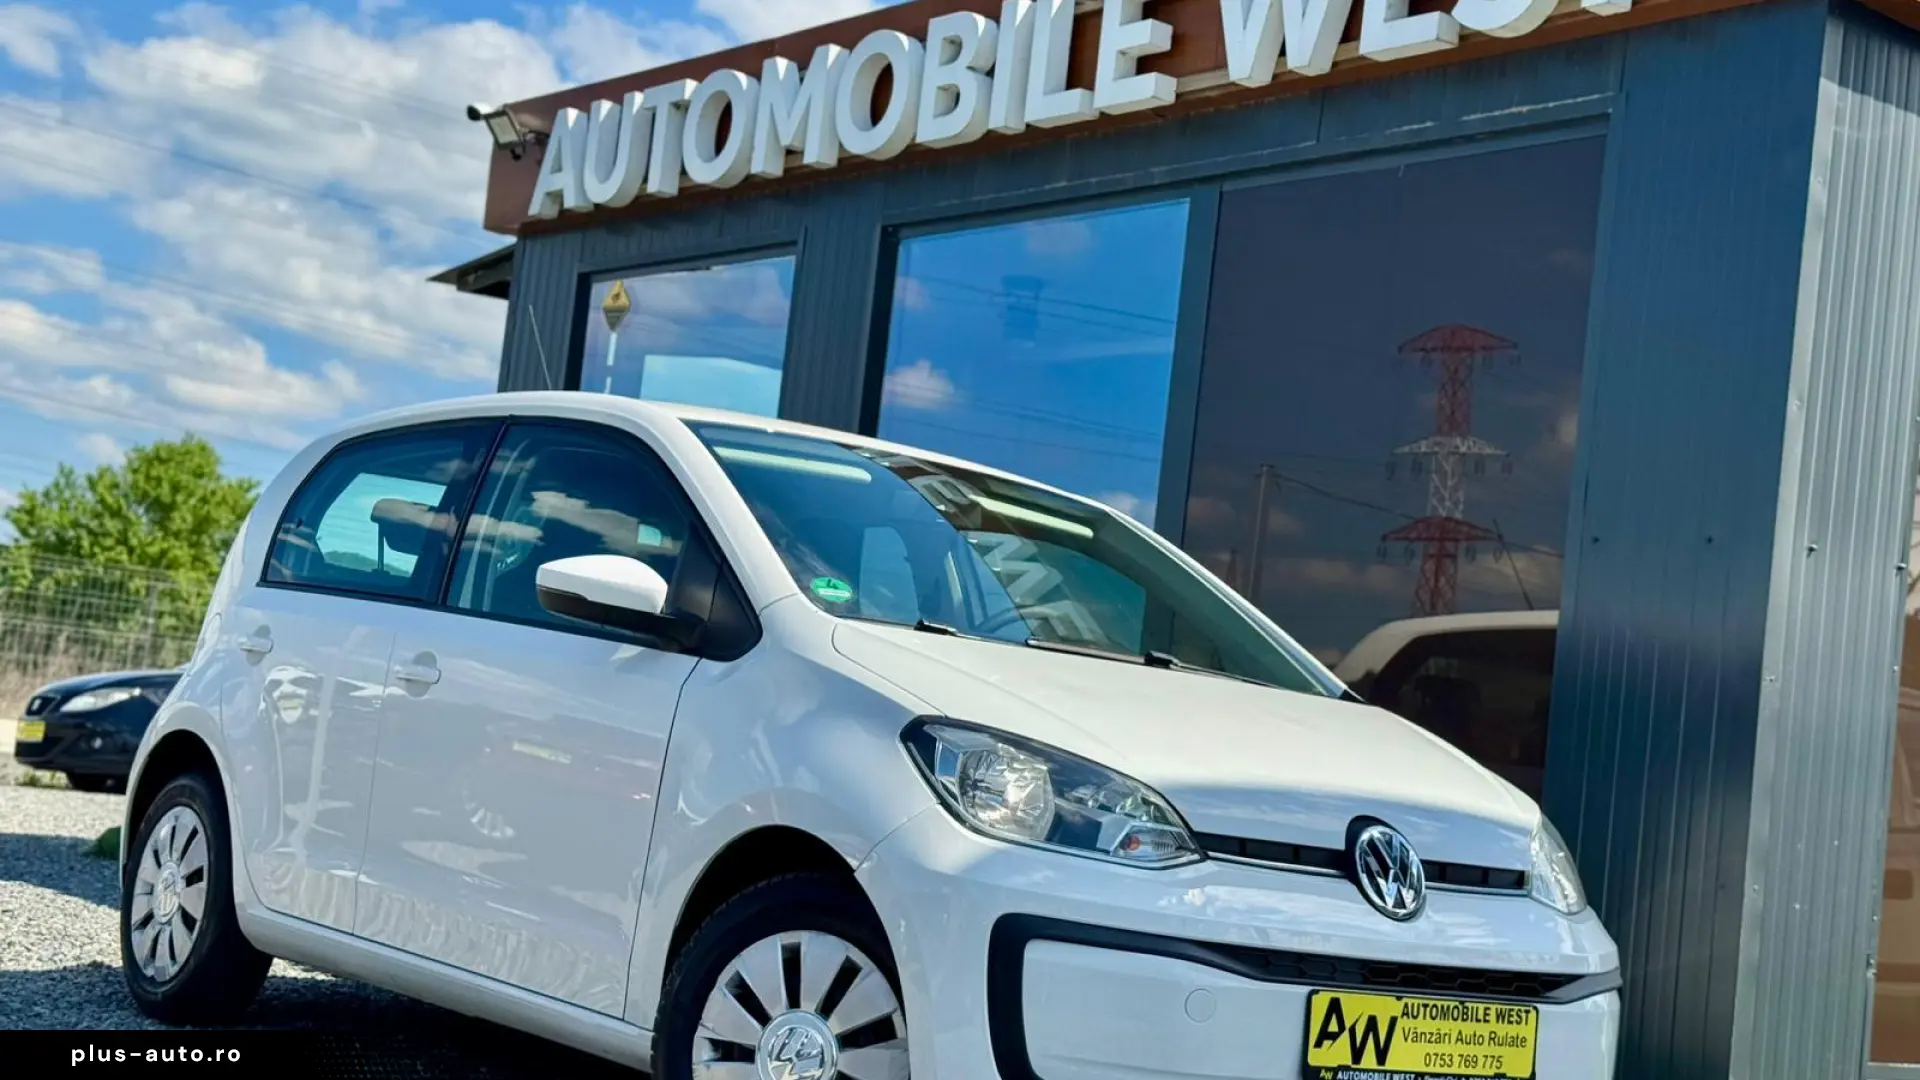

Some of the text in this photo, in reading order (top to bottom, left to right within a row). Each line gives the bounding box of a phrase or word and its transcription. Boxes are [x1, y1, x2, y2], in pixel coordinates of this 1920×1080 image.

[528, 0, 1177, 219] AUTOMOBILE
[1401, 1002, 1531, 1026] AUTOMOBILE WEST
[1455, 1030, 1485, 1047] Auto
[1488, 1031, 1528, 1049] Rulate
[1423, 1052, 1503, 1070] 0753 769 775
[1337, 1070, 1391, 1080] AUTOMOBILE
